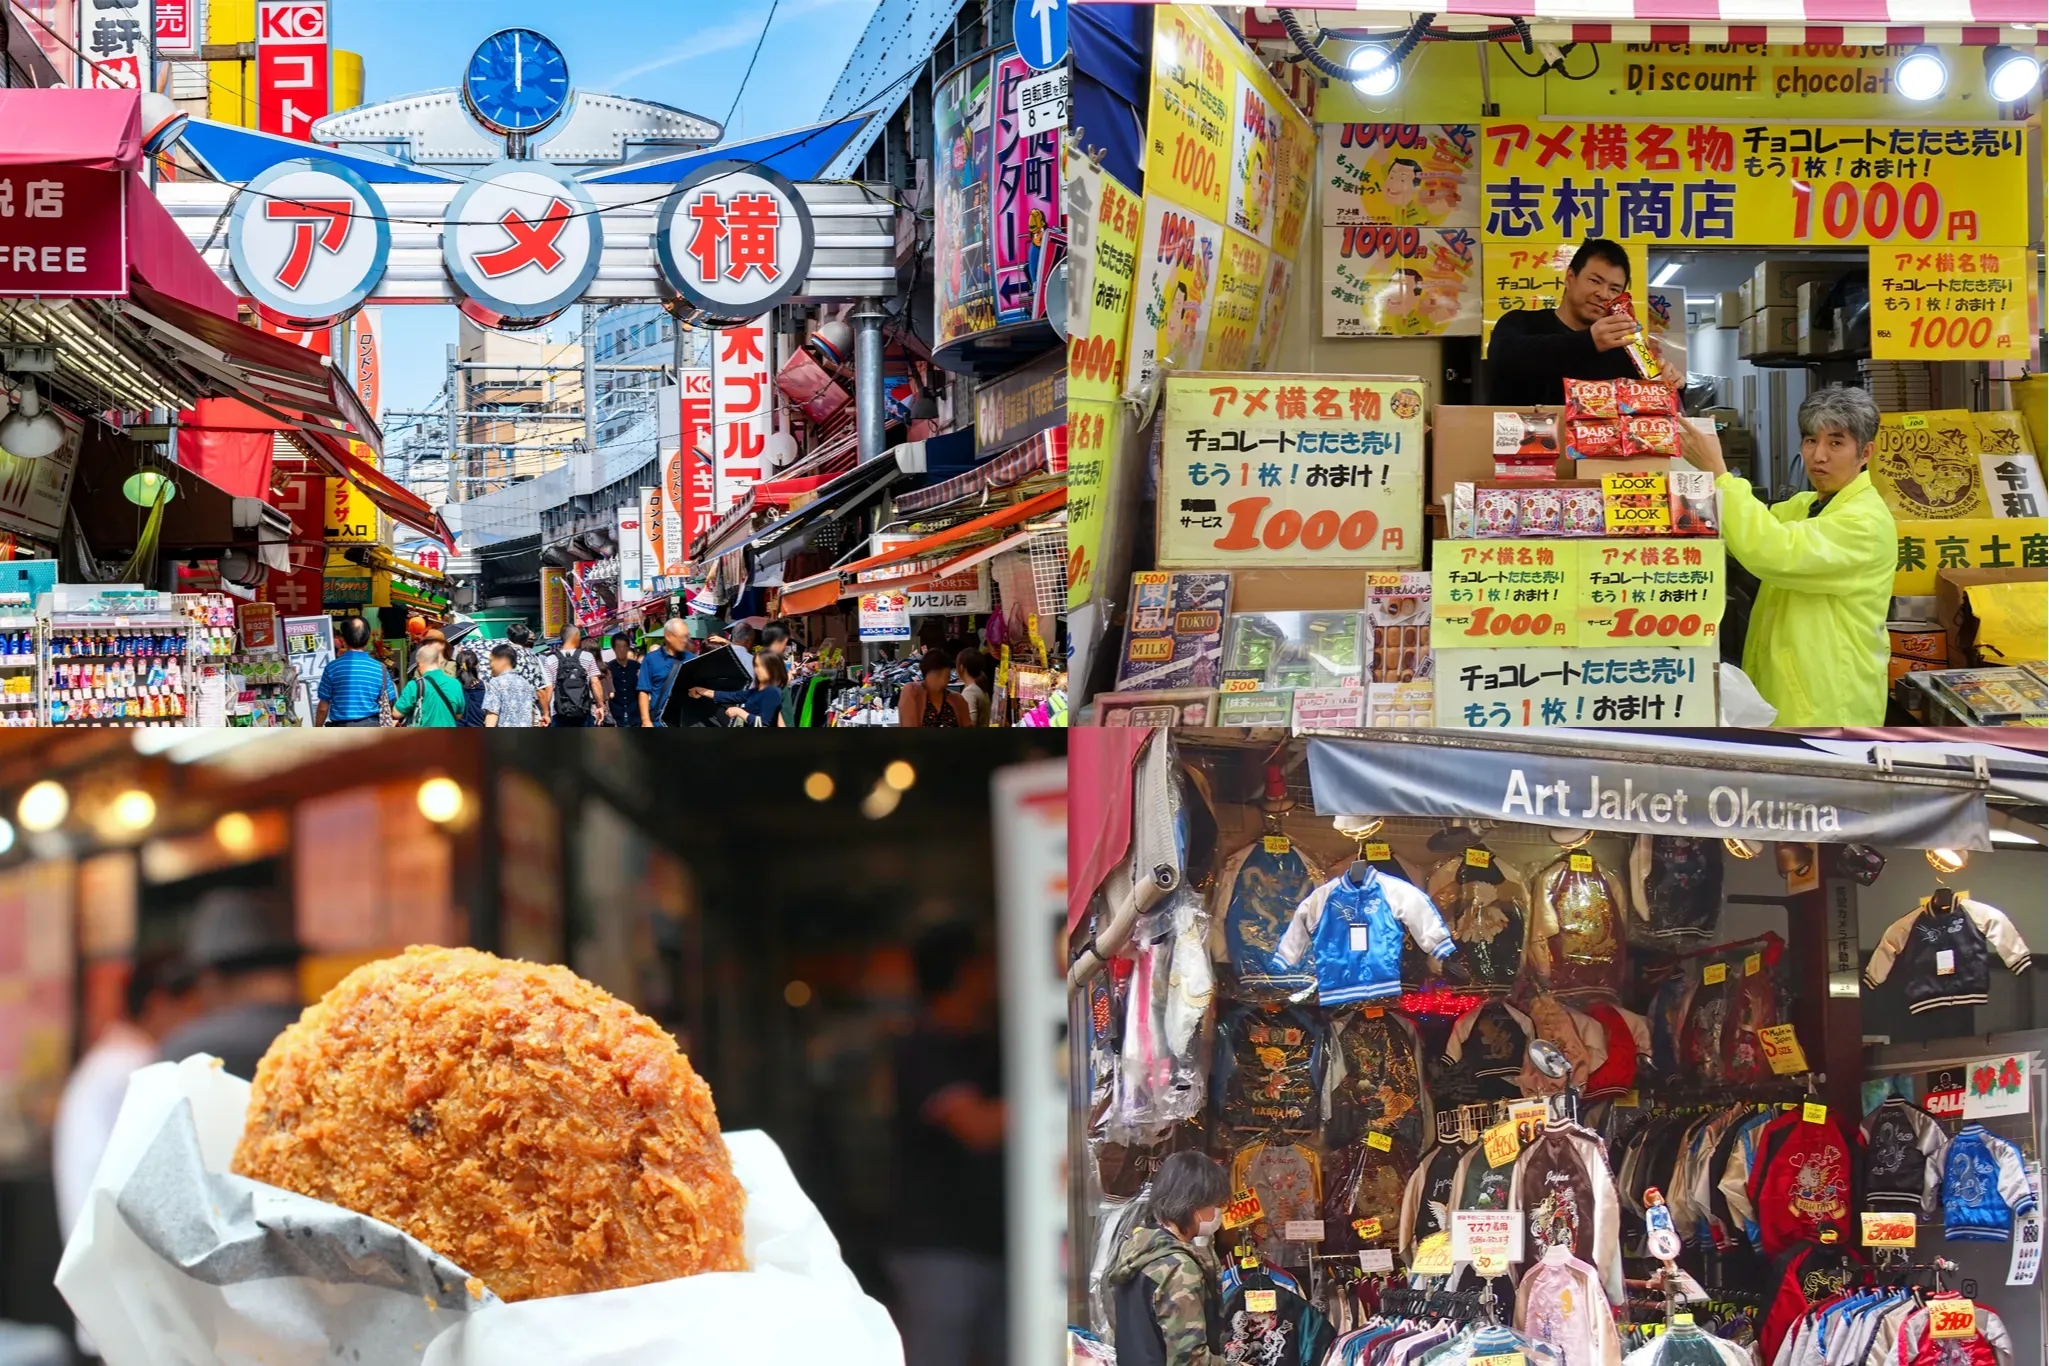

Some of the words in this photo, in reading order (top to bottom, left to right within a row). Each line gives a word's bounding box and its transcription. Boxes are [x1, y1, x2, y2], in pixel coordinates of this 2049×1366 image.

[262, 6, 323, 38] KG
[1627, 64, 1757, 92] Discount
[1776, 65, 1893, 93] chocolat
[1486, 123, 1734, 172] アメ横名物
[1743, 126, 2023, 157] チョコレートたたき売り
[1172, 131, 1221, 204] 1000円
[1744, 156, 1931, 178] もう1枚!おまけ!
[1486, 176, 1737, 239] 志村商店
[1790, 180, 1978, 241] 1000円
[1895, 253, 2000, 273] アメ横名物
[1882, 278, 2013, 293] チョコレートたたき売り
[1885, 297, 2007, 312] もう1枚!おまけ!
[1908, 316, 2012, 348] 1000円
[359, 334, 373, 382] ロンドン
[1629, 383, 1667, 397] DARS
[1640, 394, 1661, 402] and
[1209, 387, 1381, 421] アメ横名物
[1577, 426, 1614, 439] DARS
[1586, 435, 1607, 444] and
[1186, 429, 1401, 456] チョコレートたたき売り
[1188, 462, 1390, 488] もう1枚!おまけ!
[1612, 478, 1656, 490] LOOK
[1994, 461, 2040, 518] 令和
[650, 496, 661, 542] ロンドン
[1180, 516, 1223, 528] サービス
[1213, 496, 1404, 551] 1000円
[1615, 509, 1660, 521] LOOK
[343, 525, 367, 537] 入口
[1461, 547, 1555, 566] アメ横名物
[1601, 548, 1702, 566] アメ横名物
[1896, 532, 2049, 573] 東京土産
[322, 579, 369, 592] elcome
[928, 579, 970, 589] SPORTS
[1448, 570, 1565, 584] チョコレートたたき売り
[1589, 570, 1714, 584] チョコレートたたき売り
[1450, 588, 1559, 603] もう1枚!おまけ!
[1591, 588, 1707, 604] もう1枚!おまけ!
[1137, 584, 1166, 629] 東京
[1180, 614, 1214, 629] TOKYO
[1446, 617, 1469, 625] サービス
[1464, 607, 1566, 637] 1000円
[1587, 619, 1613, 627] サービス
[1606, 608, 1717, 637] 1000円
[289, 634, 328, 654] 買取
[1131, 643, 1168, 656] MILK
[1460, 656, 1696, 691] チョコレートたたき売り
[1464, 694, 1684, 727] もう1枚!おまけ!
[1502, 769, 1571, 817] Art
[1582, 775, 1688, 824] Jaket
[1708, 785, 1843, 832] Okuma
[1481, 1170, 1504, 1186] Japan
[1544, 1170, 1570, 1186] Japan
[1467, 1222, 1508, 1233] マスク着用
